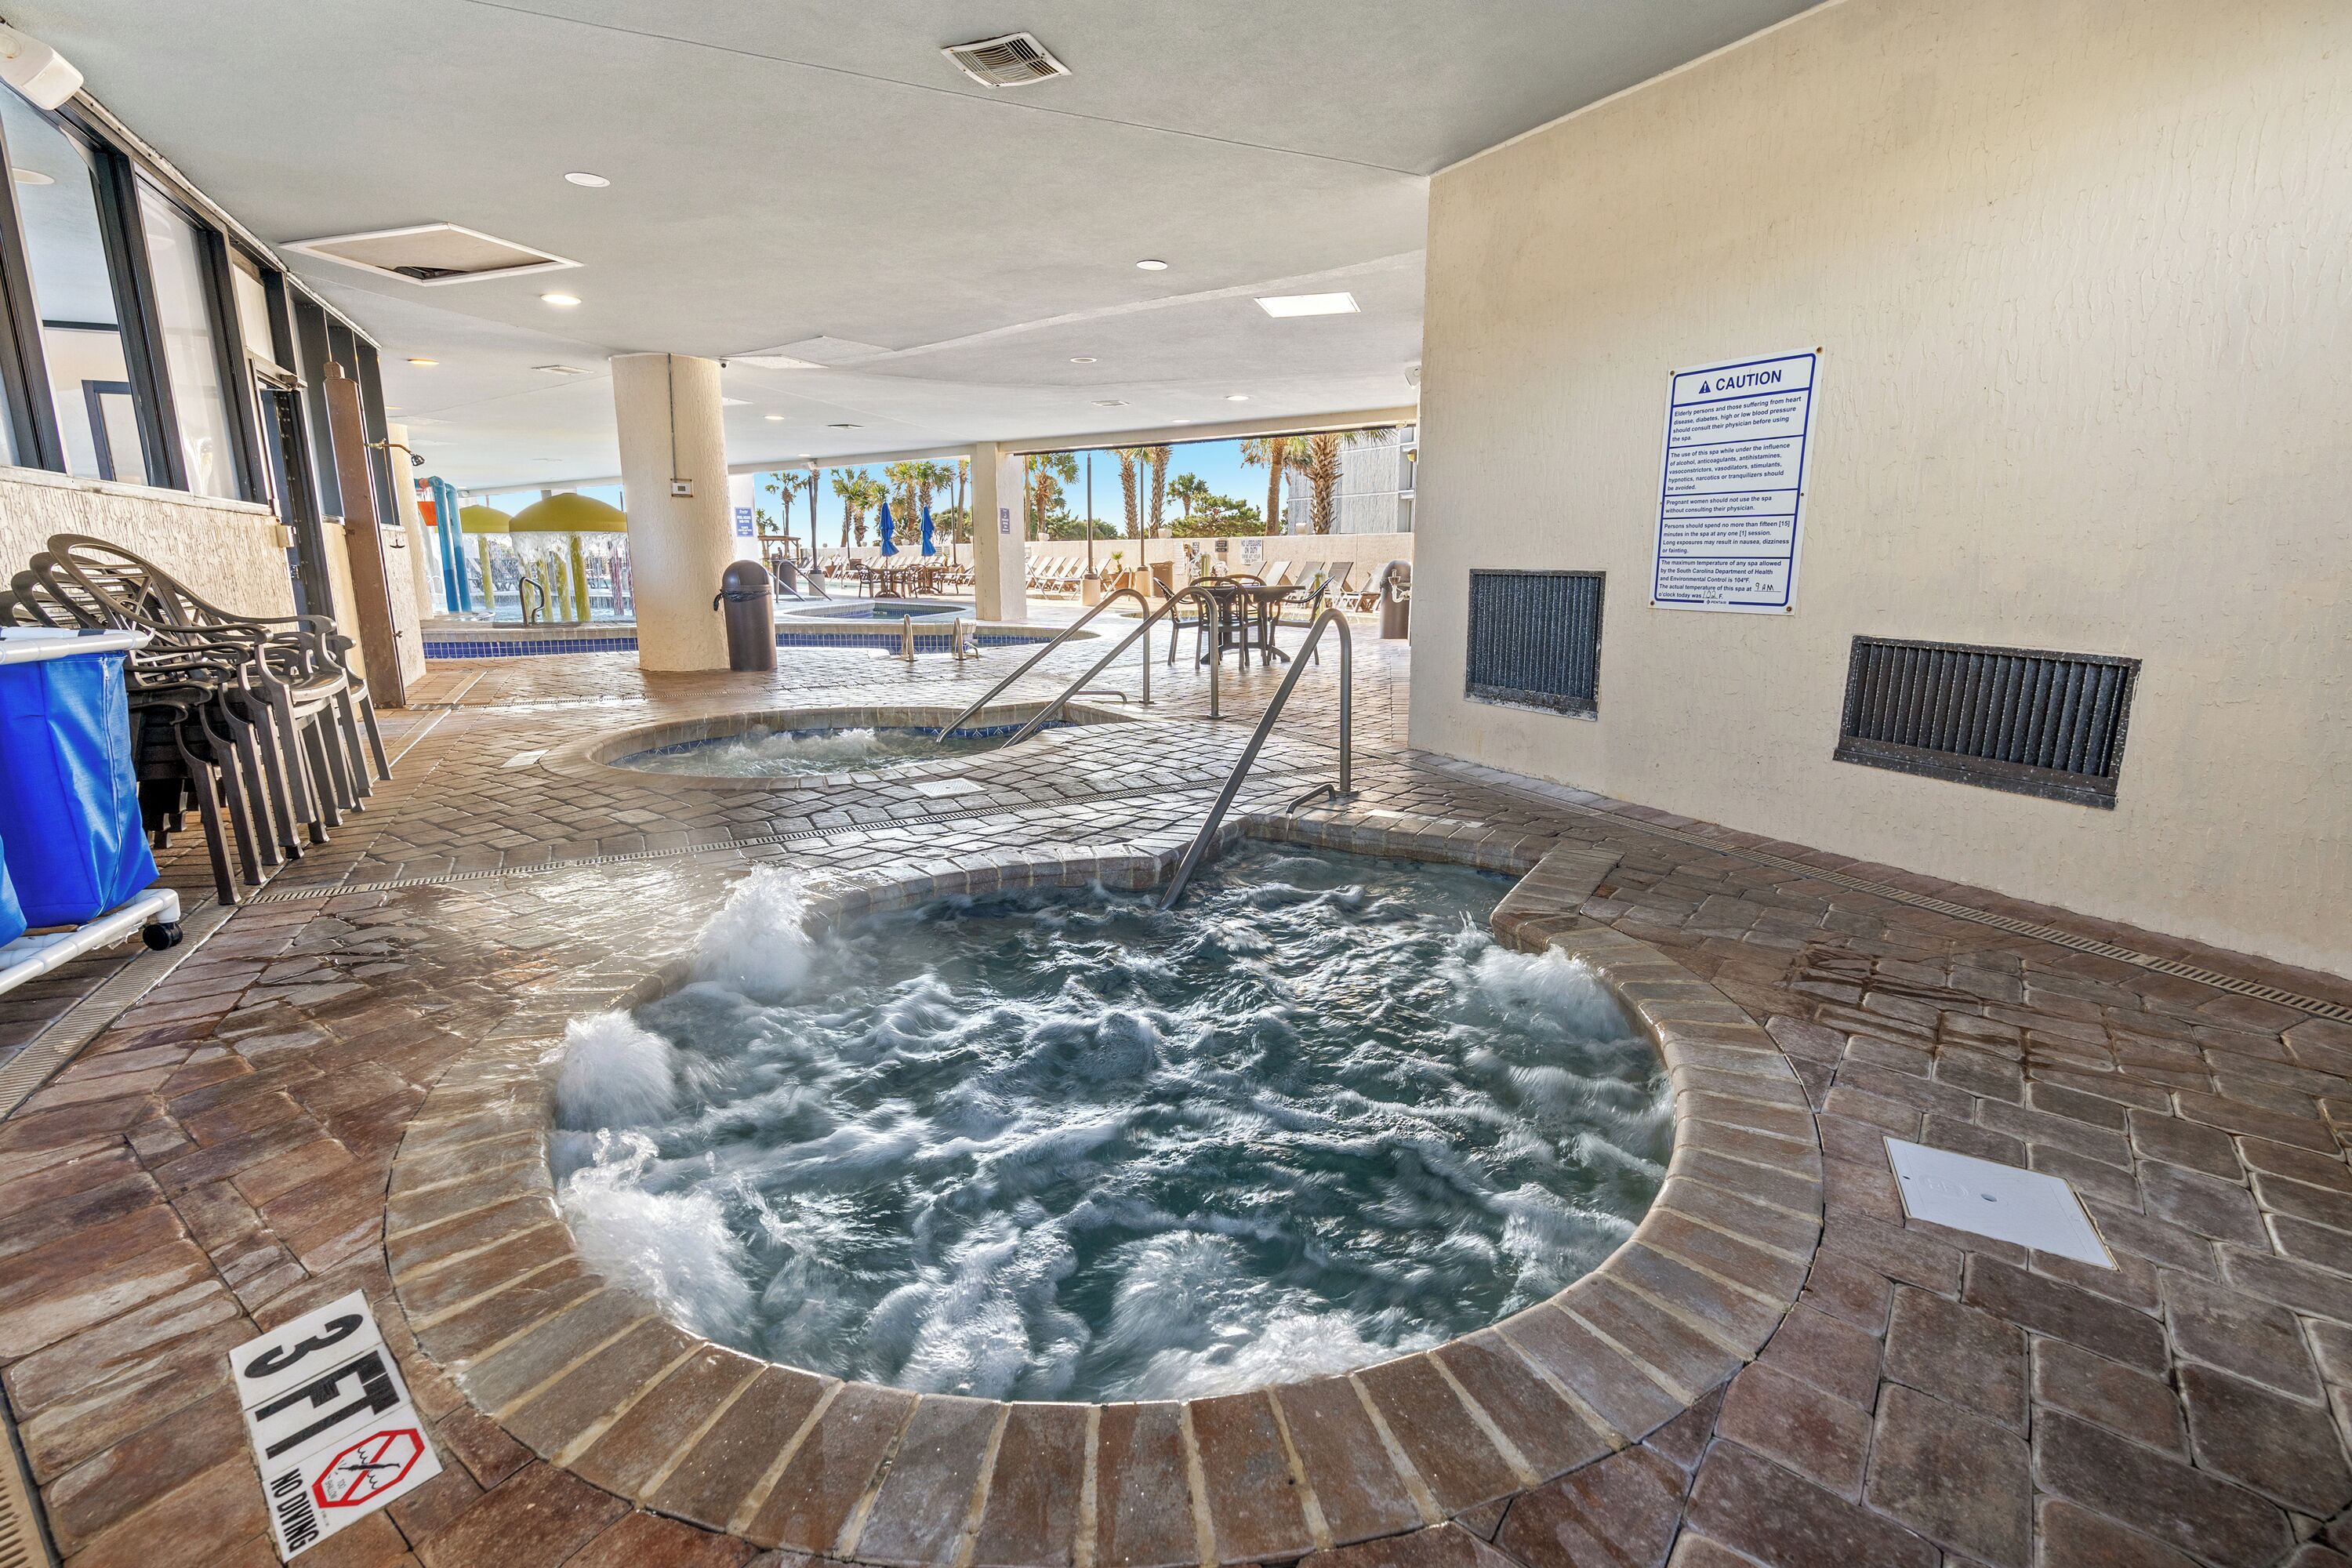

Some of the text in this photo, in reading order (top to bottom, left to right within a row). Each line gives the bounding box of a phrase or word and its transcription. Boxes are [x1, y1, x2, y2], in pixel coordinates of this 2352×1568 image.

[1716, 370, 1781, 390] CAUTION
[1769, 406, 1796, 415] pressure
[1726, 420, 1751, 430] physician
[1697, 456, 1737, 465] anticoagulants,
[244, 1314, 363, 1377] 3
[255, 1350, 400, 1460] FT
[325, 1480, 337, 1500] SHALLOW
[337, 1479, 347, 1489] TOO
[270, 1468, 320, 1552] NO DIVING
